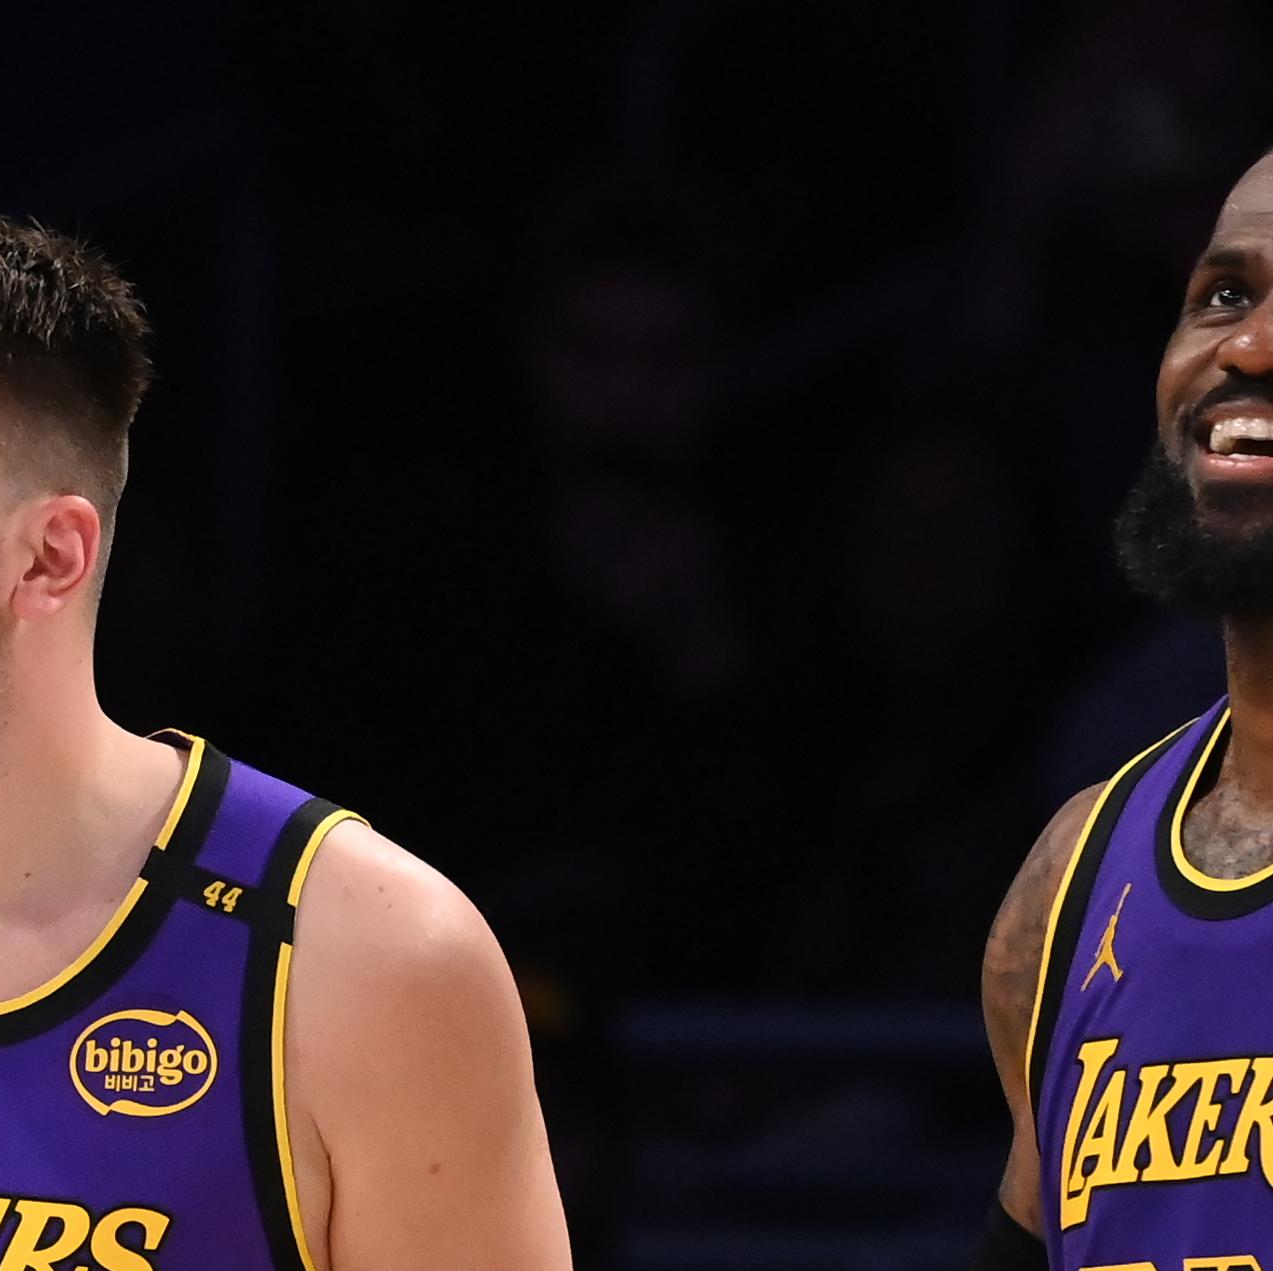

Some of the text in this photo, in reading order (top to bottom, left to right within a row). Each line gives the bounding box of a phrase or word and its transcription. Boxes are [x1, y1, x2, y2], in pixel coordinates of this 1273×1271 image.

[203, 880, 243, 913] 44
[85, 1037, 208, 1086] bibigo
[104, 1074, 155, 1092] 비비고
